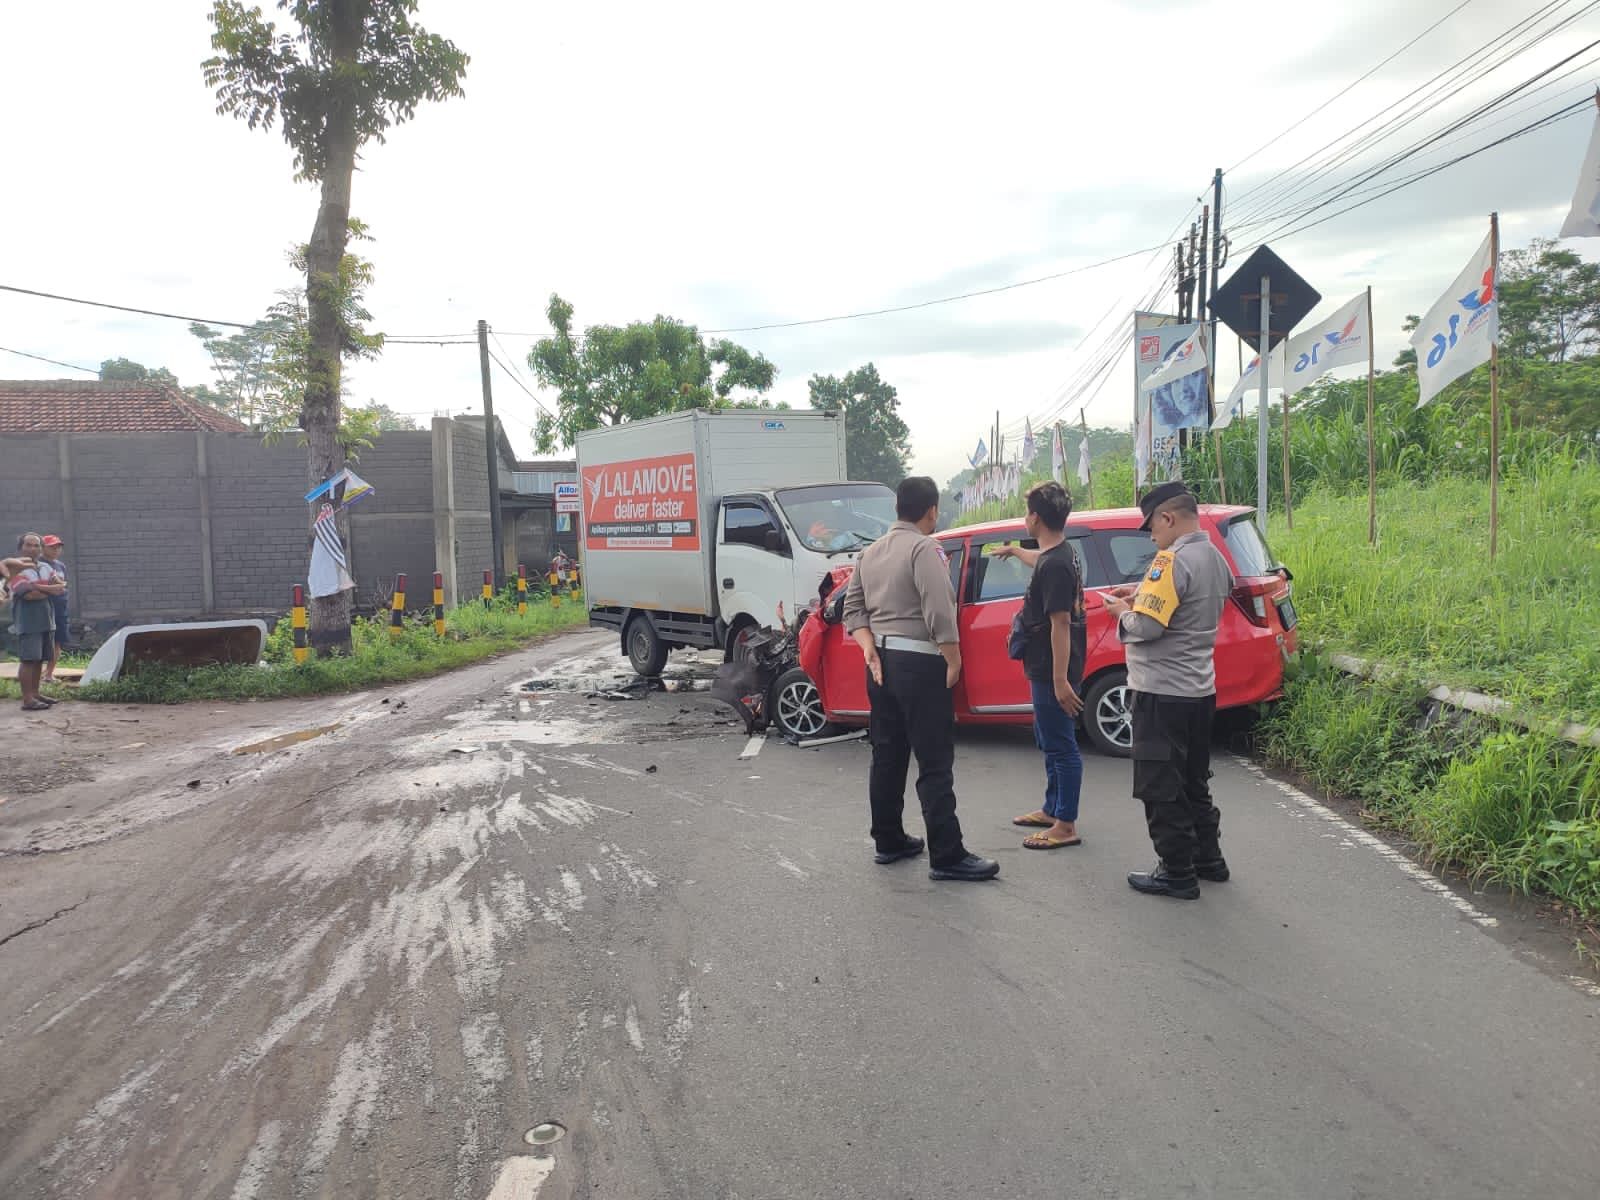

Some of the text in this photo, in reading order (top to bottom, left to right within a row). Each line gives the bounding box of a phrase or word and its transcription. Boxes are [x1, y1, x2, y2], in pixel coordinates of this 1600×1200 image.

[604, 464, 693, 498] LALAMOVE
[614, 497, 685, 520] deliver faster
